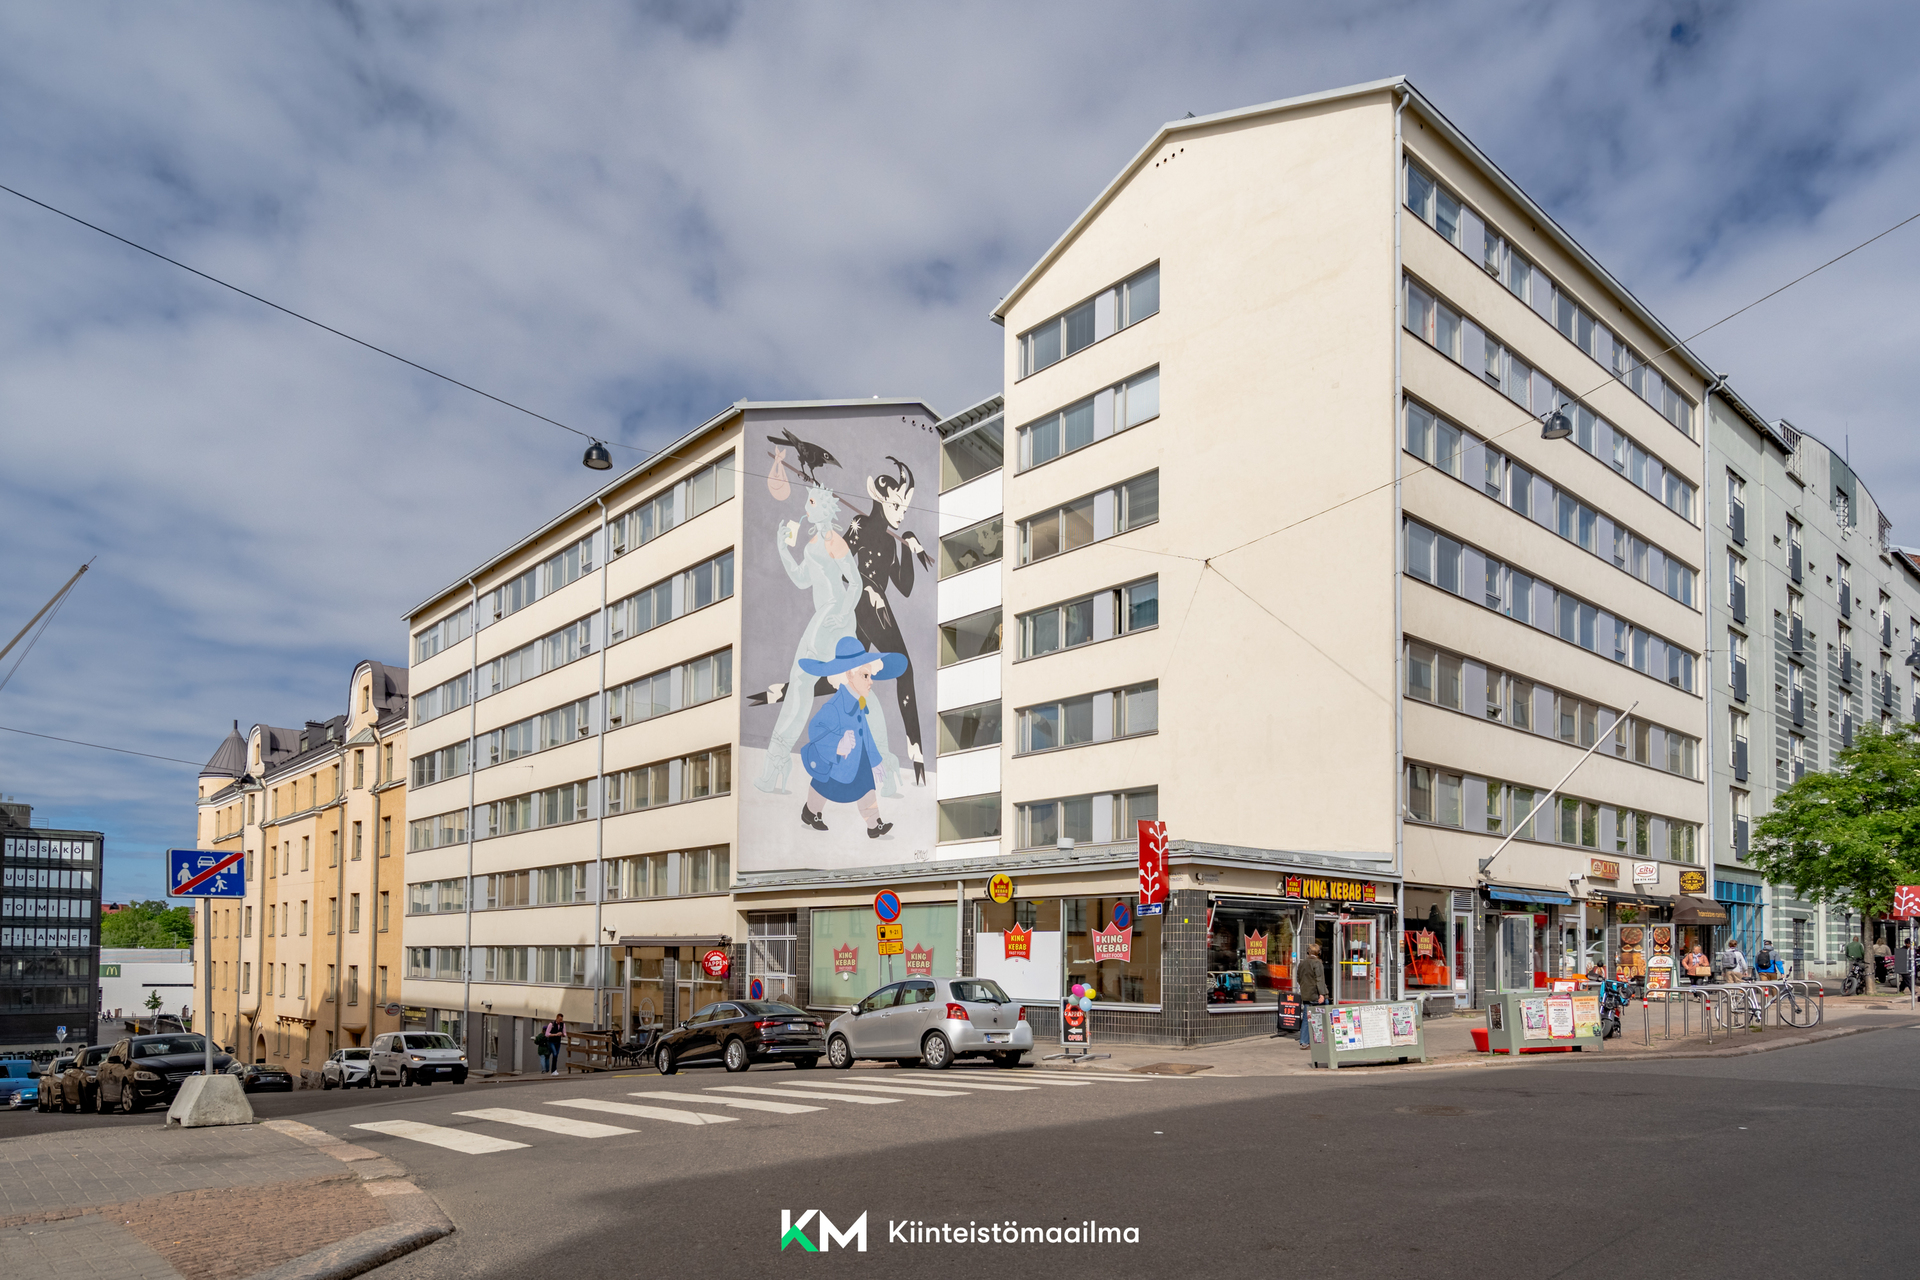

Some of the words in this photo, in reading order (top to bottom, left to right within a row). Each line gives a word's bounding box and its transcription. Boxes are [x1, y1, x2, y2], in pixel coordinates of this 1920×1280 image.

[7, 843, 81, 854] TÄSSÄKÖ
[1602, 861, 1619, 874] CITY
[1639, 865, 1654, 874] city
[5, 873, 45, 882] UUSI
[1302, 879, 1327, 899] KING
[1330, 881, 1362, 901] KEBAB
[4, 903, 67, 911] TOIMI-
[3, 933, 88, 941] TILANNE?
[1101, 934, 1123, 944] KING
[1096, 943, 1129, 953] KEBAB
[835, 958, 856, 966] KEBAB
[907, 960, 931, 968] KEBAB
